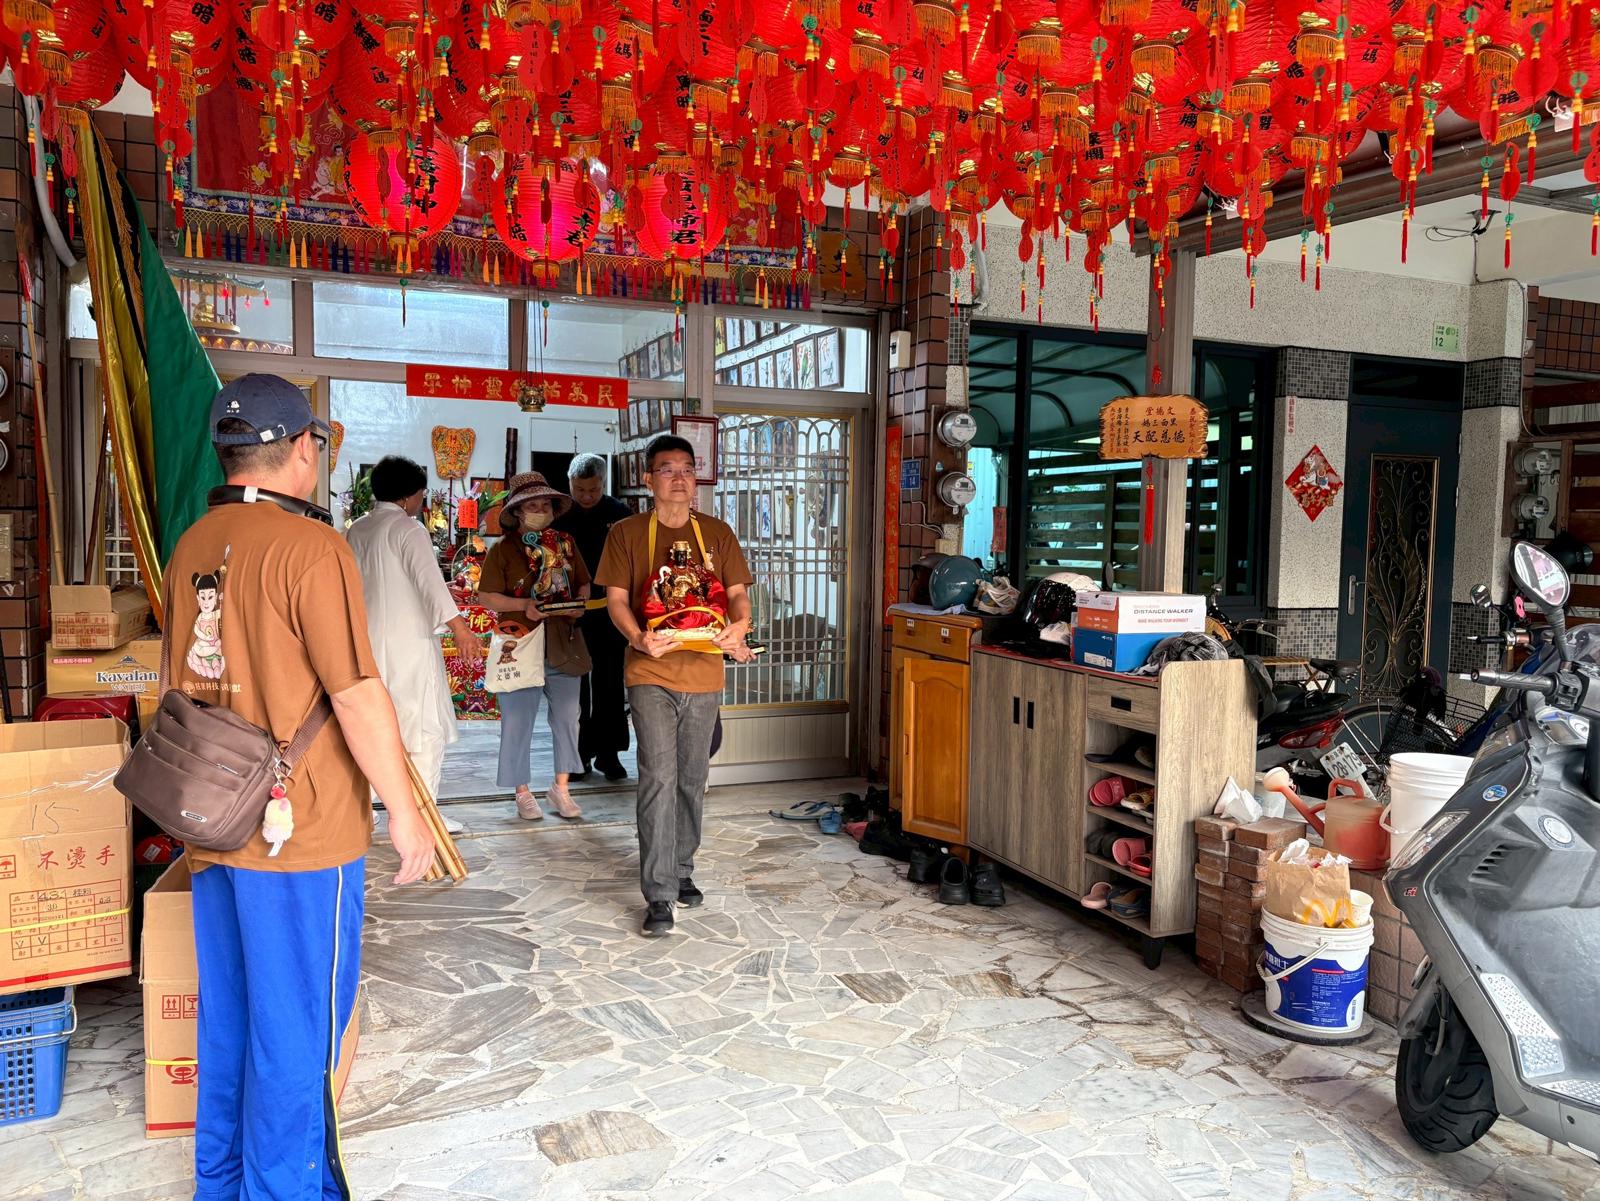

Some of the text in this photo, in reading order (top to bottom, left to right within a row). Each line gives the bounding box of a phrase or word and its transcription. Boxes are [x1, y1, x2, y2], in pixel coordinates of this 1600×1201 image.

[1435, 336, 1444, 347] 12
[468, 613, 492, 632] 佛
[97, 671, 159, 683] Kavalan
[37, 844, 116, 870] 不燙手
